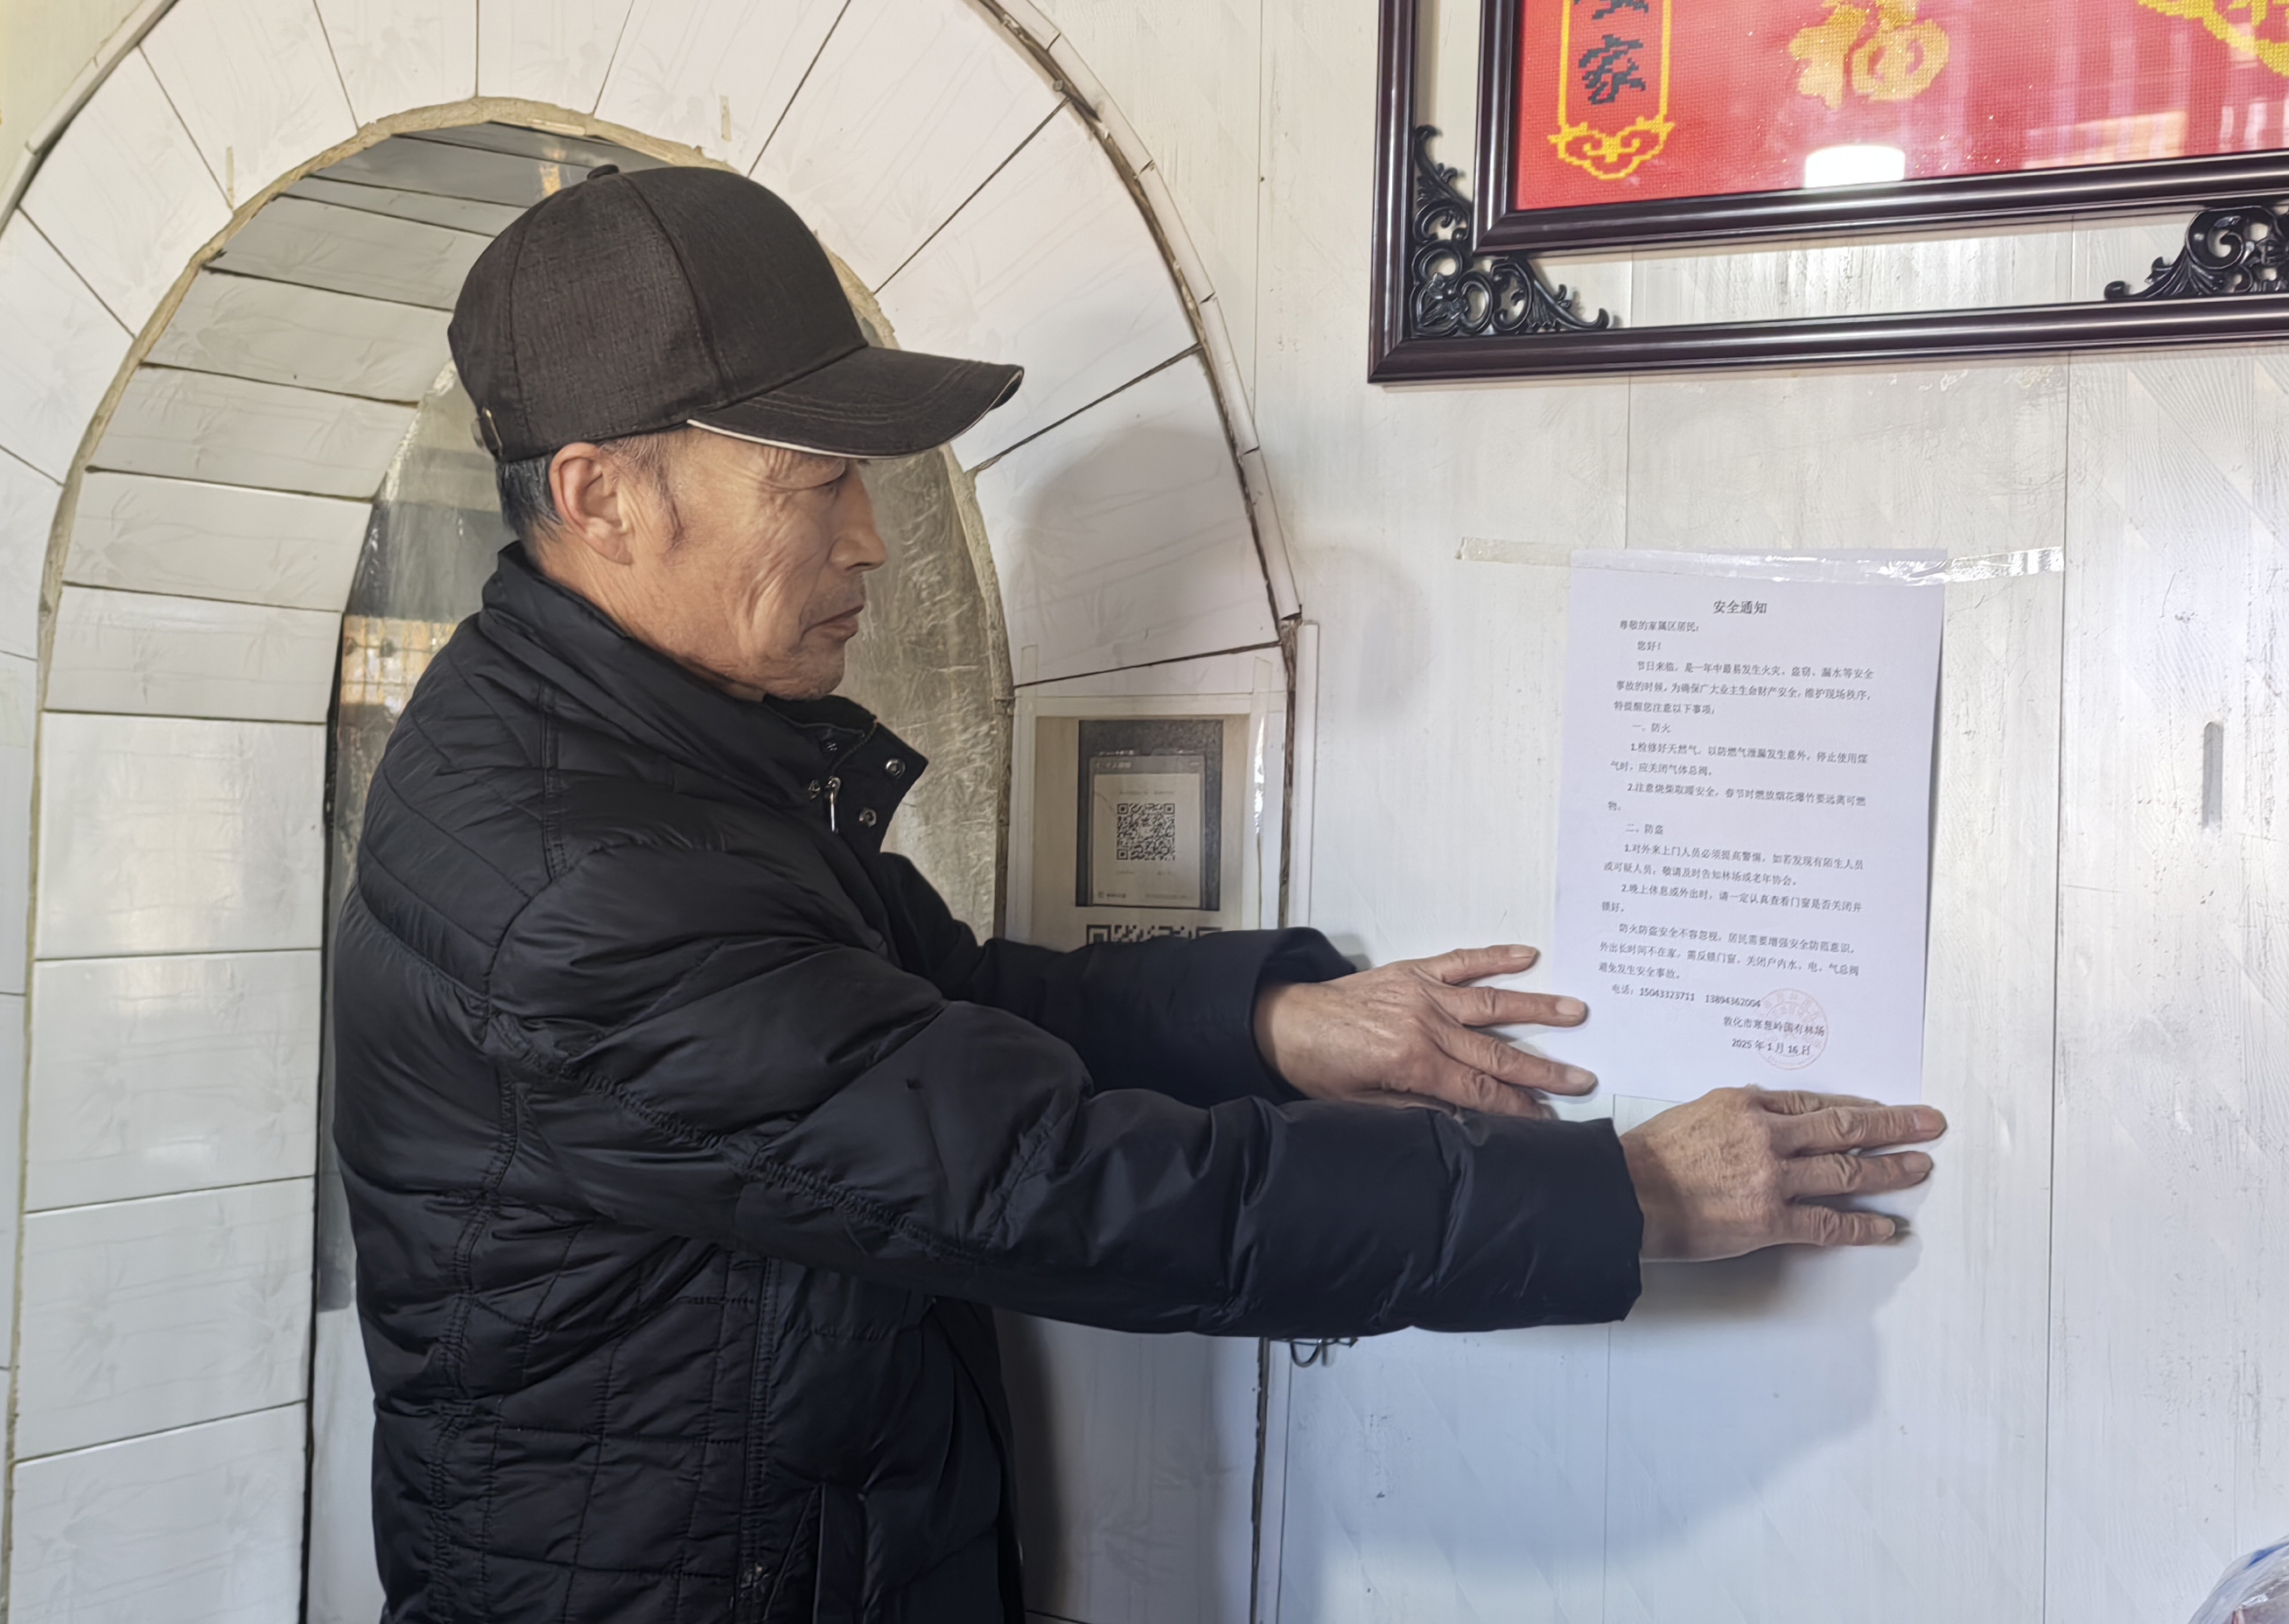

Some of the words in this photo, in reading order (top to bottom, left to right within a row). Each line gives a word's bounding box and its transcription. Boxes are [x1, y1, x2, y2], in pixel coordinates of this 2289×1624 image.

[1574, 0, 1648, 105] 家
[1712, 599, 1768, 615] 安全通知
